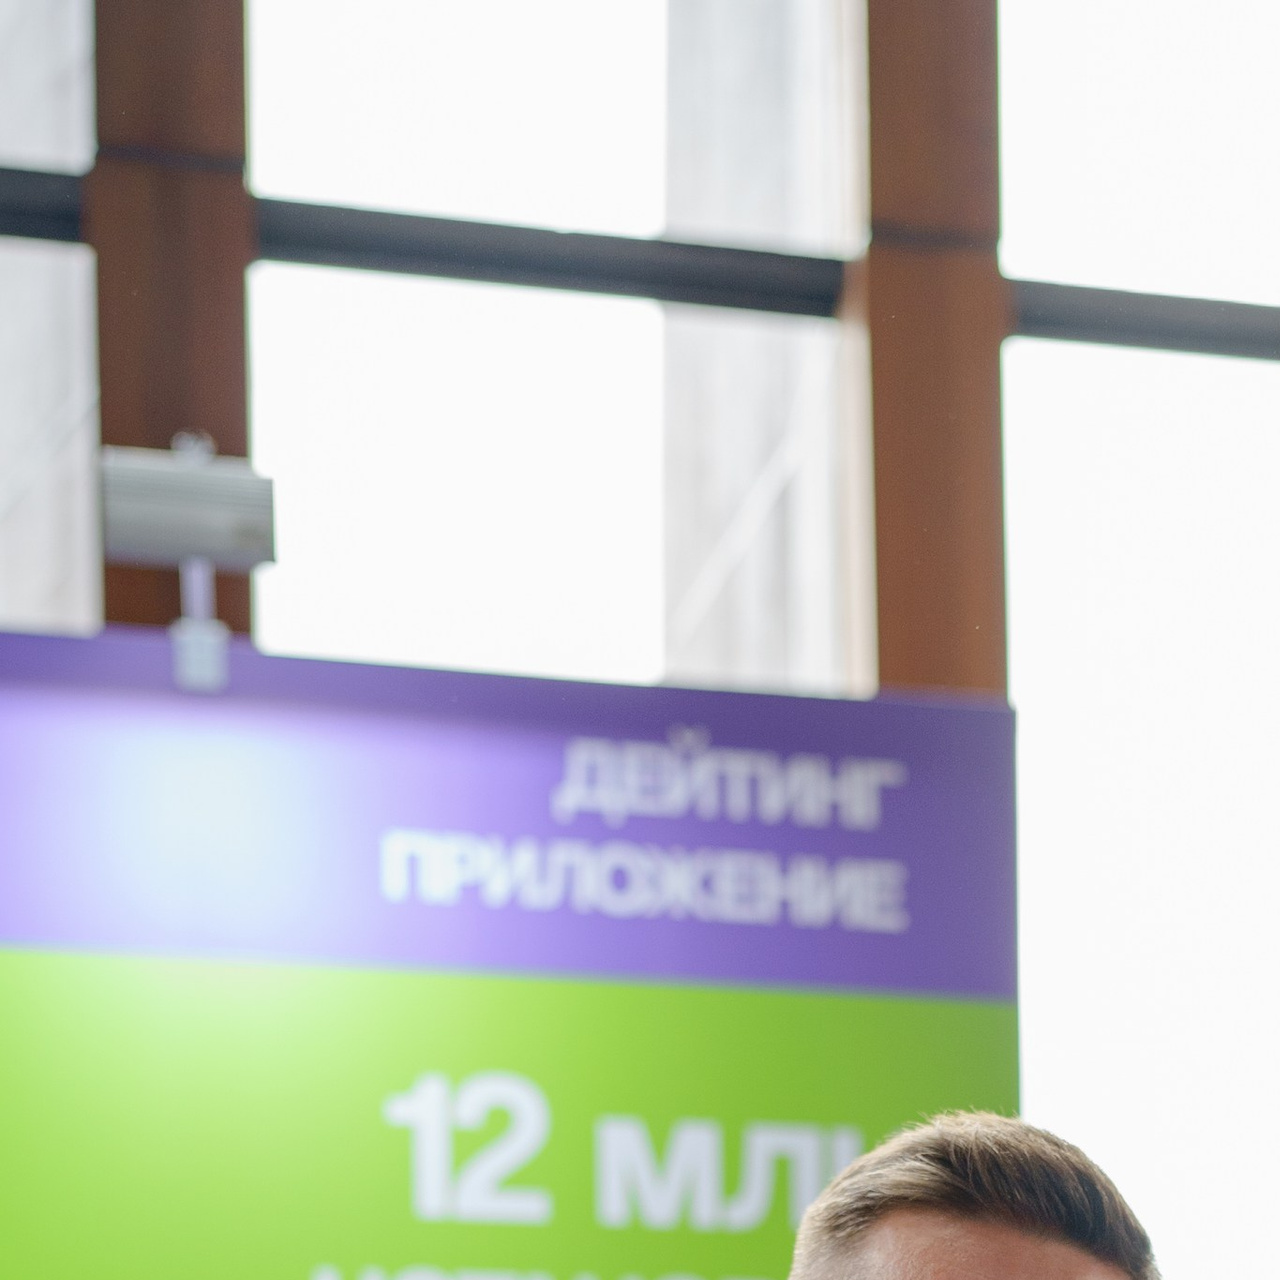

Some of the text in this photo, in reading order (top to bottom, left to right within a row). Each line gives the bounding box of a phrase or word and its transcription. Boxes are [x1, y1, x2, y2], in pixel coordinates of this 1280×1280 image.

[551, 726, 905, 829] ДЕЙТИНГ
[380, 828, 908, 933] ПРИЛОЖЕНИЕ
[383, 1072, 862, 1232] 12 МЛ
